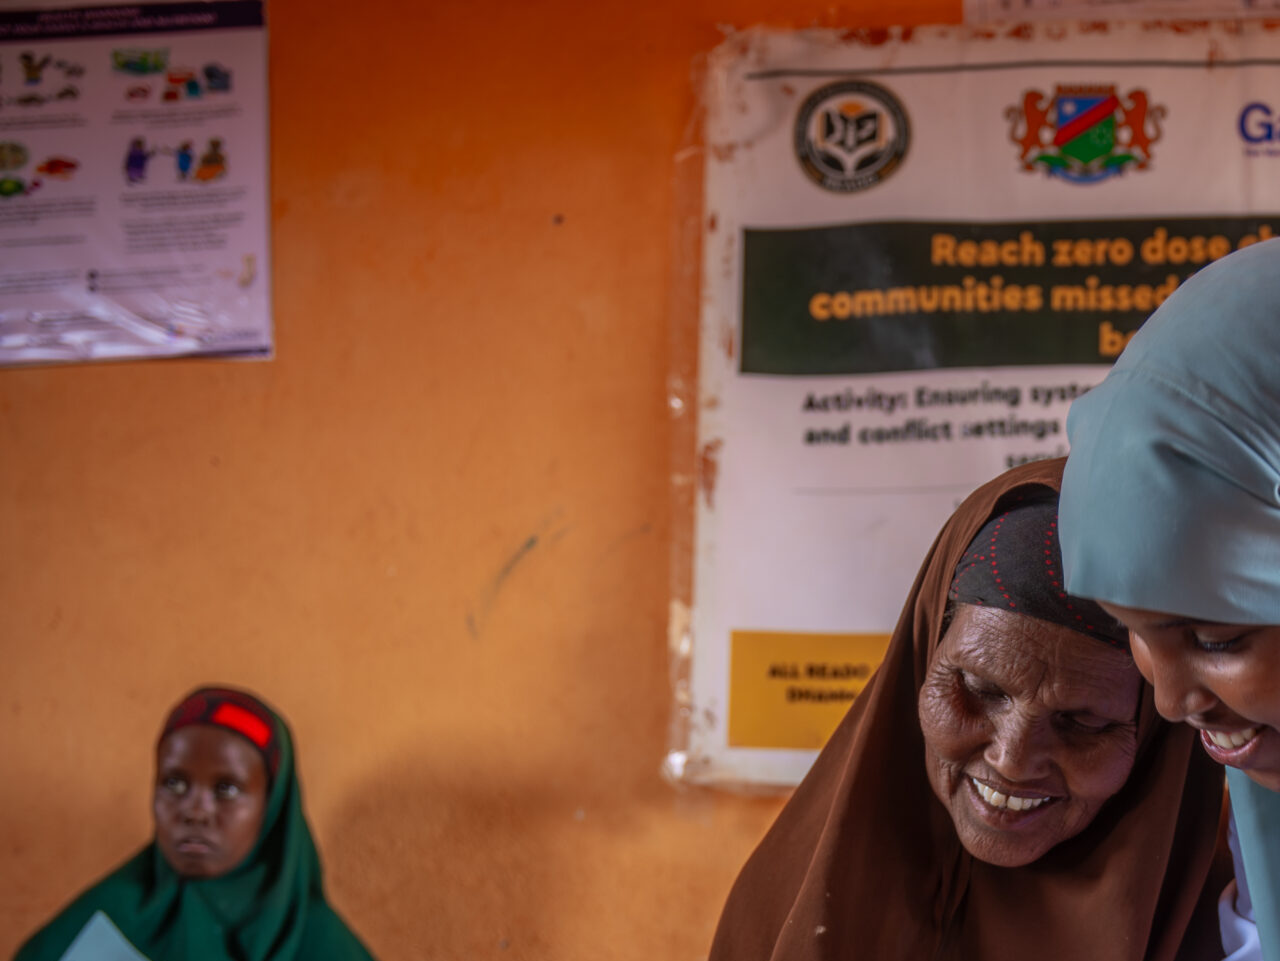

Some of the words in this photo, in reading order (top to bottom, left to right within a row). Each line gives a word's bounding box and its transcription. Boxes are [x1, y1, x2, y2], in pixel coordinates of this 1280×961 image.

[931, 231, 1045, 266] Reach
[1053, 238, 1134, 266] zero
[1141, 227, 1231, 264] dose
[809, 275, 1043, 320] communities
[803, 386, 907, 413] Activity:
[916, 381, 1021, 407] Ensuring
[804, 423, 850, 445] and
[859, 418, 952, 444] conflict
